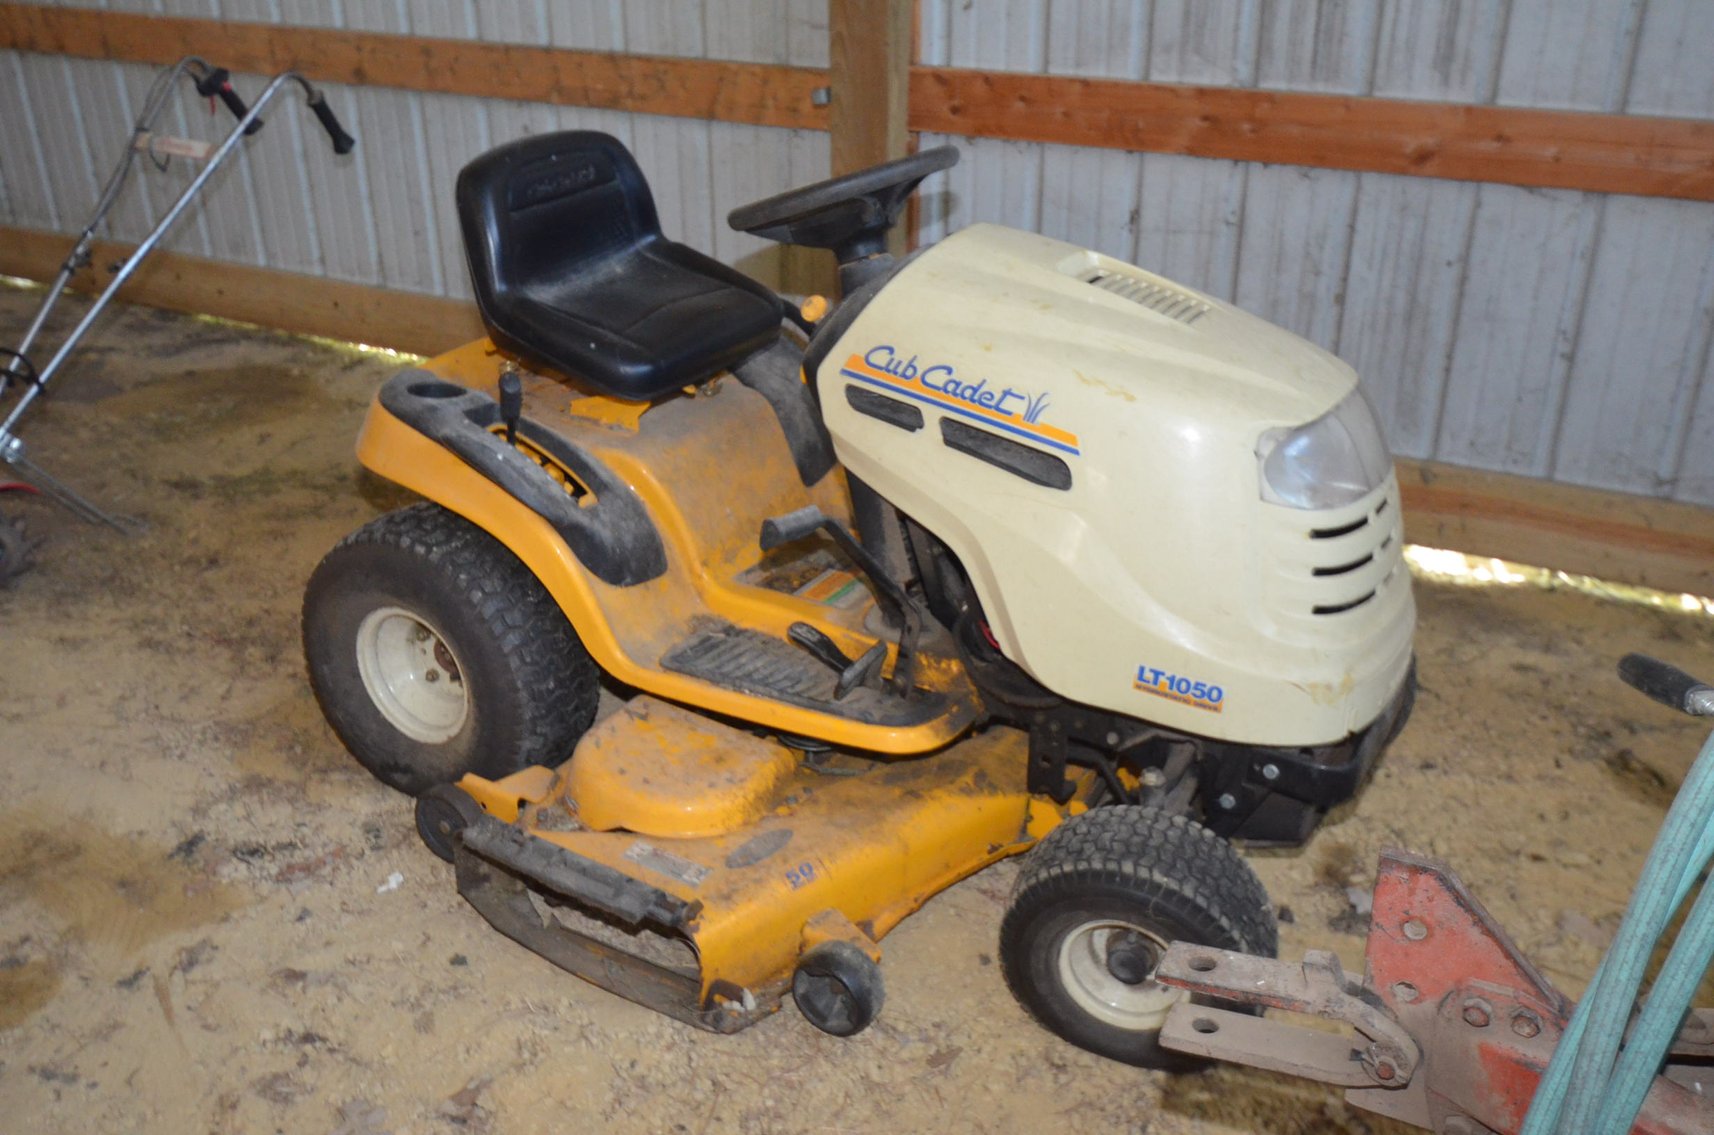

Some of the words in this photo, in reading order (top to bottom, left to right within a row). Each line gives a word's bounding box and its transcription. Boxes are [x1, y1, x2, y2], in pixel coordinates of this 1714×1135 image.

[864, 345, 918, 380] Cub
[920, 365, 1025, 416] Cadet
[1137, 665, 1223, 703] LT1050
